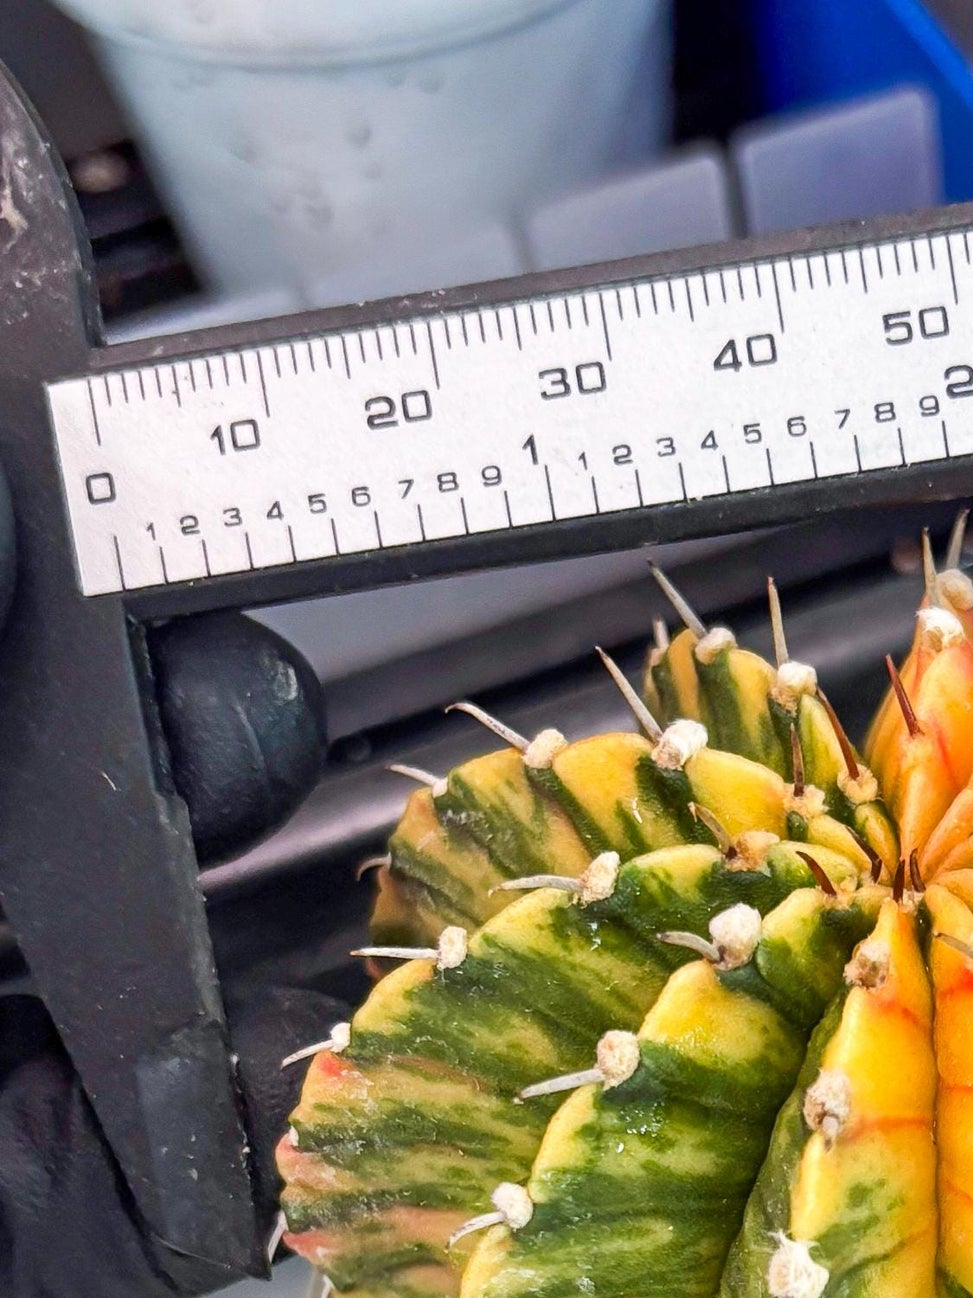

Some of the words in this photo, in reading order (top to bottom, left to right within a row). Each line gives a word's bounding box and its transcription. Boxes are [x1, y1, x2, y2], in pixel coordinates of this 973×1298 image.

[85, 471, 117, 505] 0
[210, 418, 261, 455] 10
[364, 389, 433, 430] 20
[538, 361, 607, 400] 30
[713, 333, 778, 372] 40
[882, 305, 950, 346] 50
[146, 522, 156, 541] 1
[179, 514, 200, 536] 2
[223, 507, 243, 527] 3
[266, 500, 284, 520] 4
[307, 493, 327, 514] 5
[351, 486, 371, 507] 6
[398, 479, 414, 499] 7
[436, 471, 459, 493] 8
[481, 465, 502, 487] 9
[521, 434, 538, 465] 1
[578, 451, 588, 470] 1
[612, 444, 633, 466] 2
[656, 436, 676, 457] 3
[700, 430, 719, 450] 4
[742, 422, 762, 444] 5
[786, 415, 807, 437] 6
[835, 408, 851, 429] 7
[873, 401, 897, 423] 8
[919, 394, 941, 417] 9
